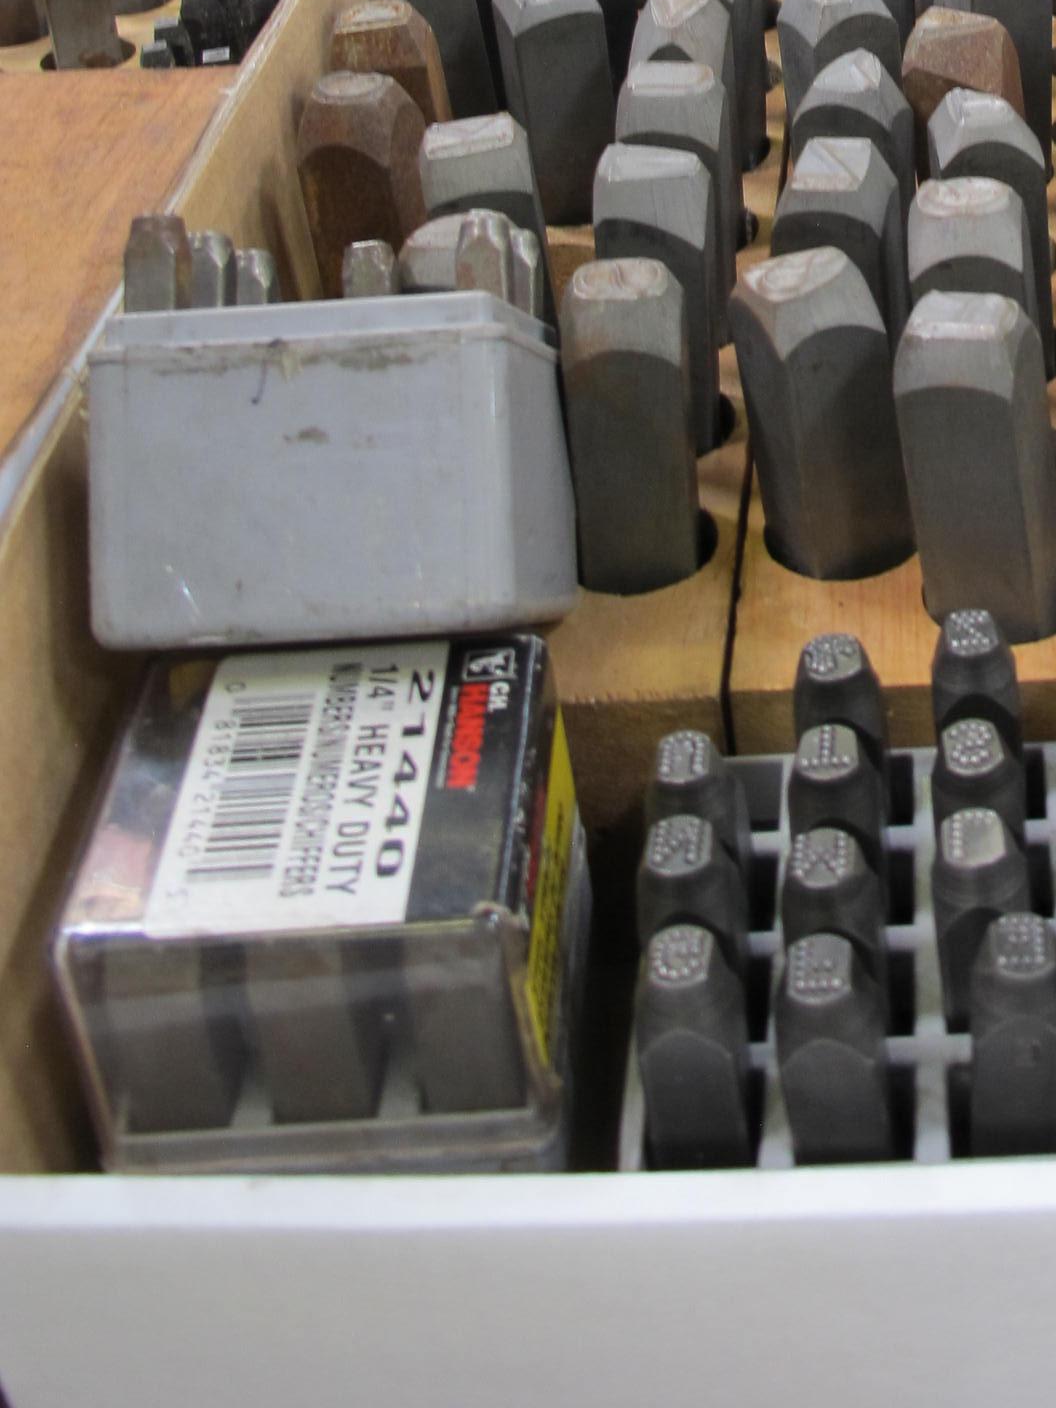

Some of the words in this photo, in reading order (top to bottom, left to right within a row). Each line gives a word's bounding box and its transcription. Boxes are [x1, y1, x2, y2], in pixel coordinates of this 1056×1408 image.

[343, 723, 391, 808] HEAVY
[376, 668, 435, 879] 21440
[446, 681, 490, 790] HANSON
[325, 821, 371, 895] DUTY
